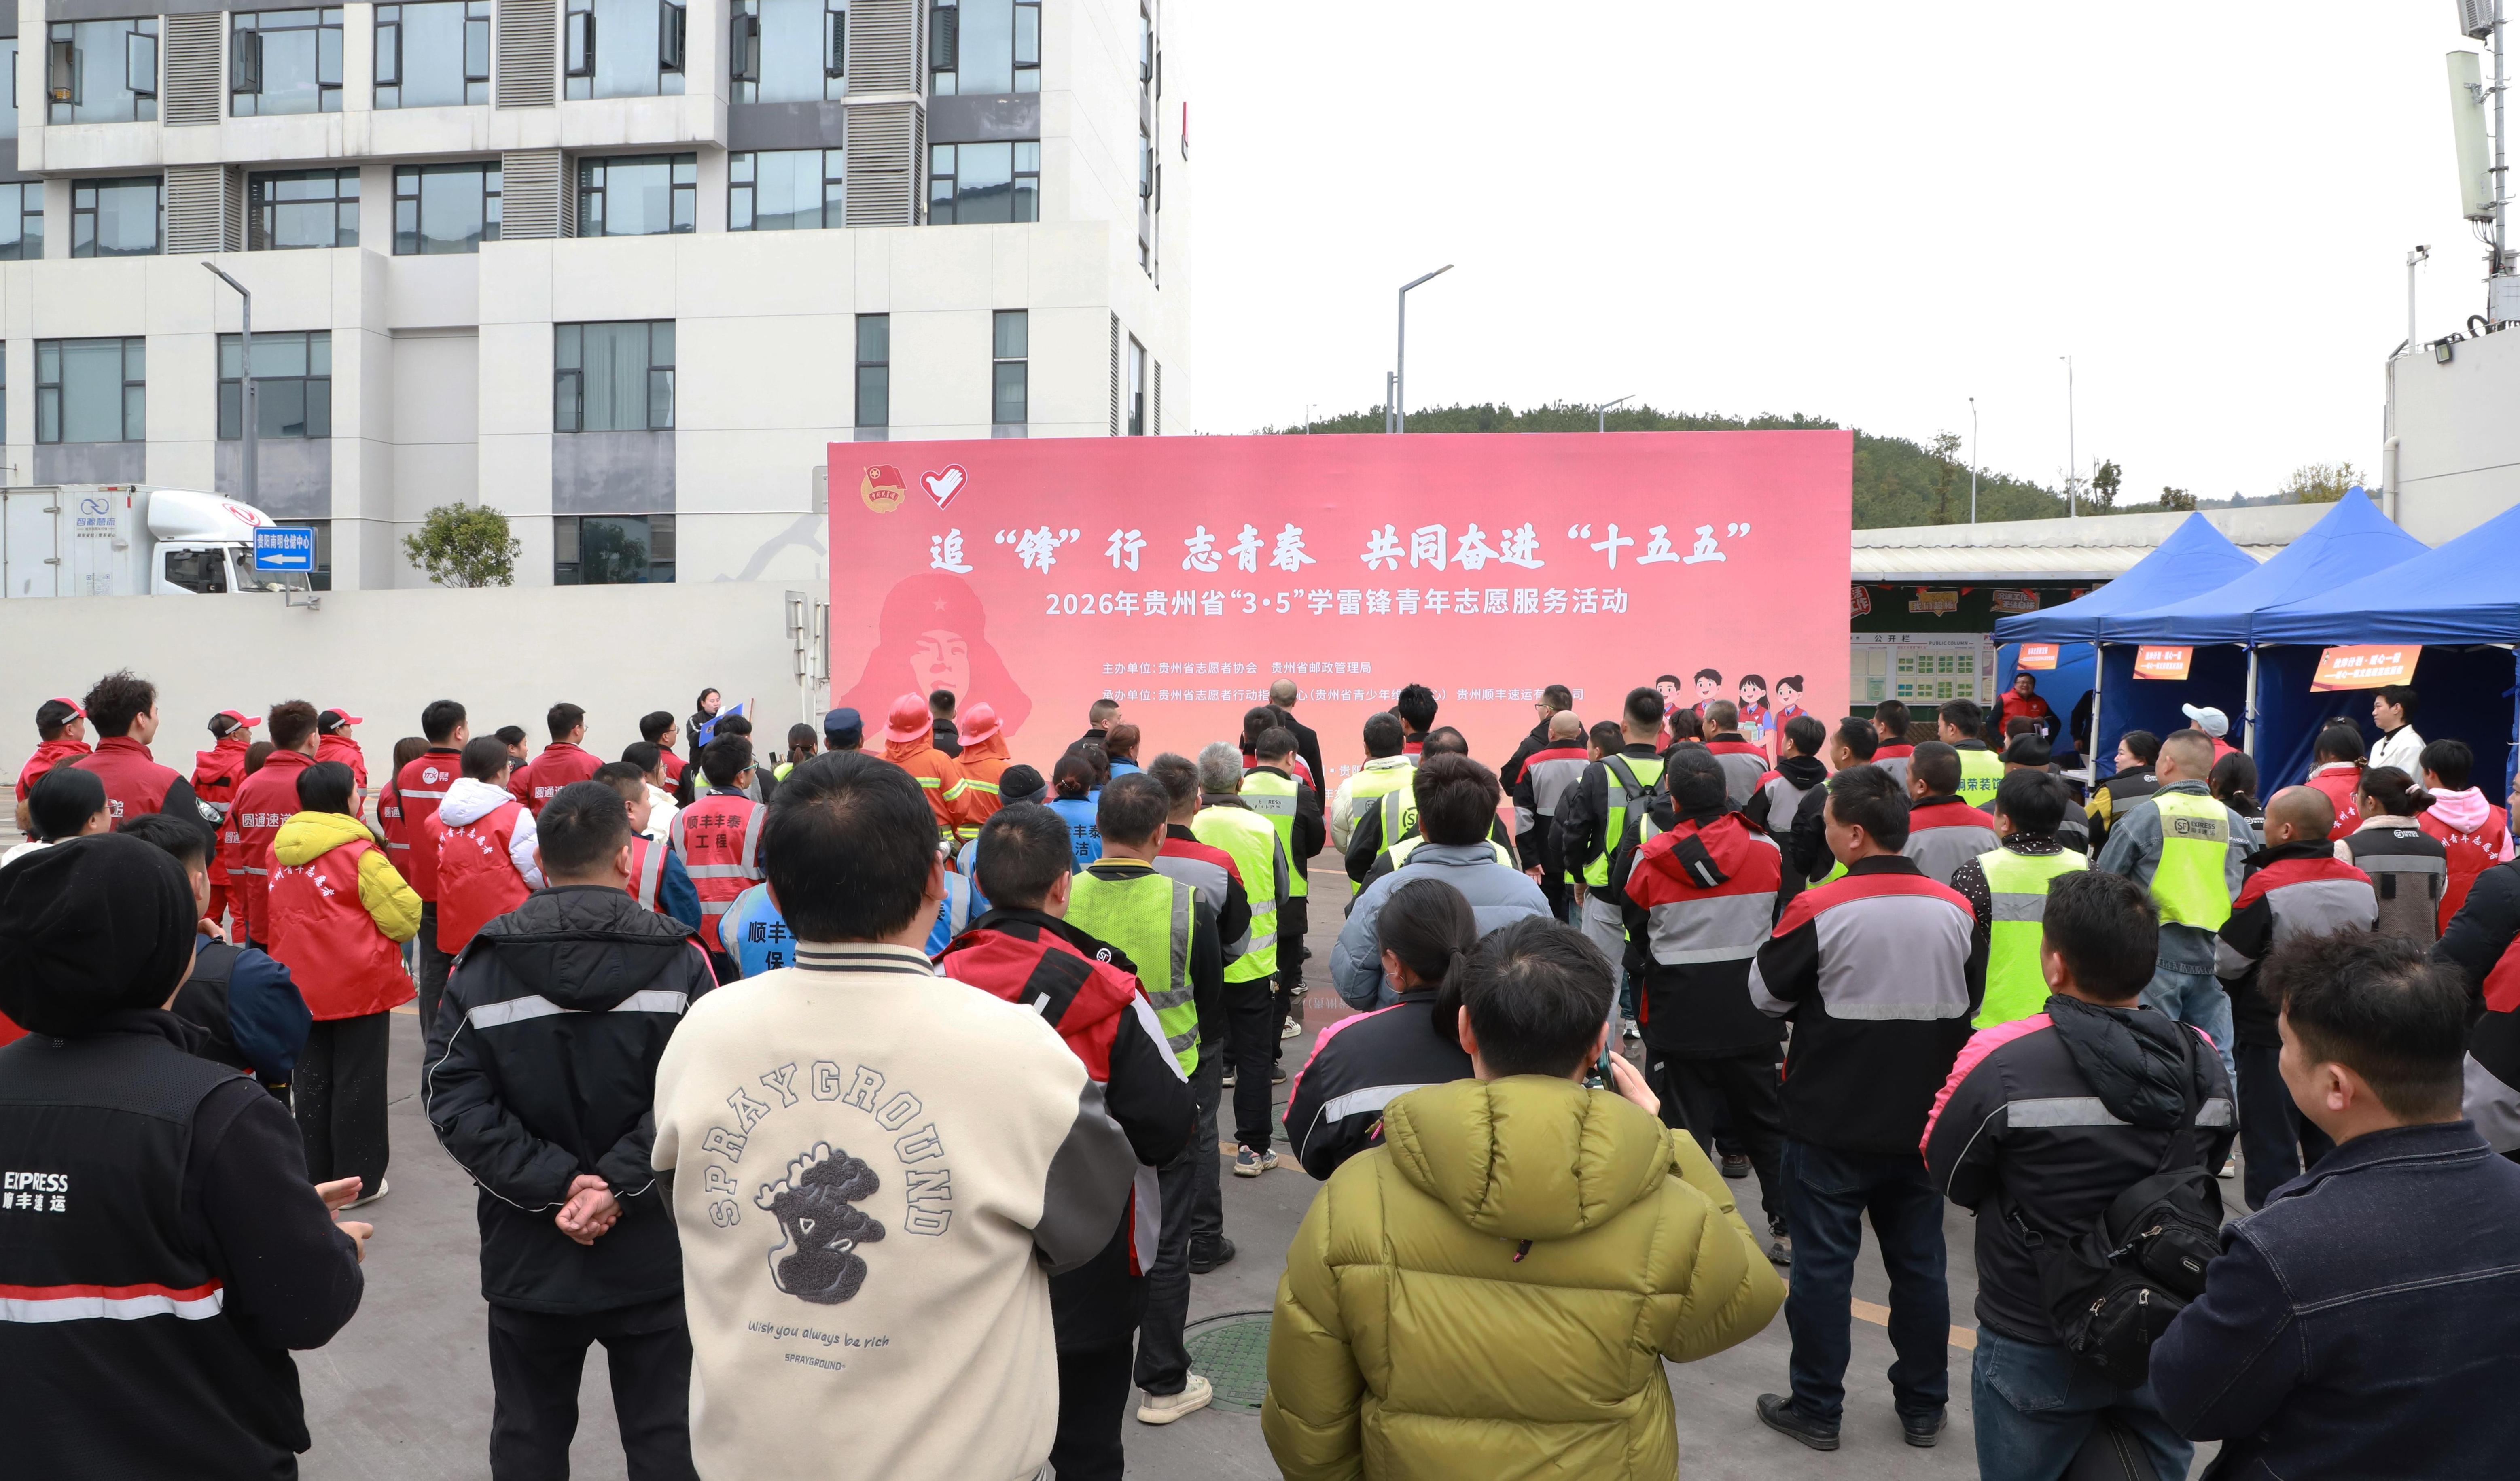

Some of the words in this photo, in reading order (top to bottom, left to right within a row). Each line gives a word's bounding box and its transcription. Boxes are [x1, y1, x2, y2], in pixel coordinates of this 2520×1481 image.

[257, 534, 309, 549] 贵阳南明仓储中心
[1181, 523, 1317, 573] 志青春
[1045, 587, 1629, 617] 2026年贵州省“3·5”学雷锋青年志愿服务活动
[1272, 662, 1371, 674] 贵州省邮政管理局
[1456, 688, 1584, 701] 贵州顺丰速运有司
[384, 807, 401, 817] 圆通
[687, 815, 742, 829] 顺丰丰泰
[1068, 824, 1100, 838] 丰泰
[695, 835, 727, 848] 工程
[1075, 842, 1089, 856] 洁
[702, 1061, 952, 1237] SPRAYGROUND
[4, 1172, 68, 1192] EXPRESS
[3, 1192, 66, 1212] 顺丰速运
[748, 1321, 773, 1332] Wish
[774, 1325, 798, 1339] you
[802, 1326, 839, 1346] always
[844, 1333, 861, 1347] be
[864, 1336, 889, 1347] rich
